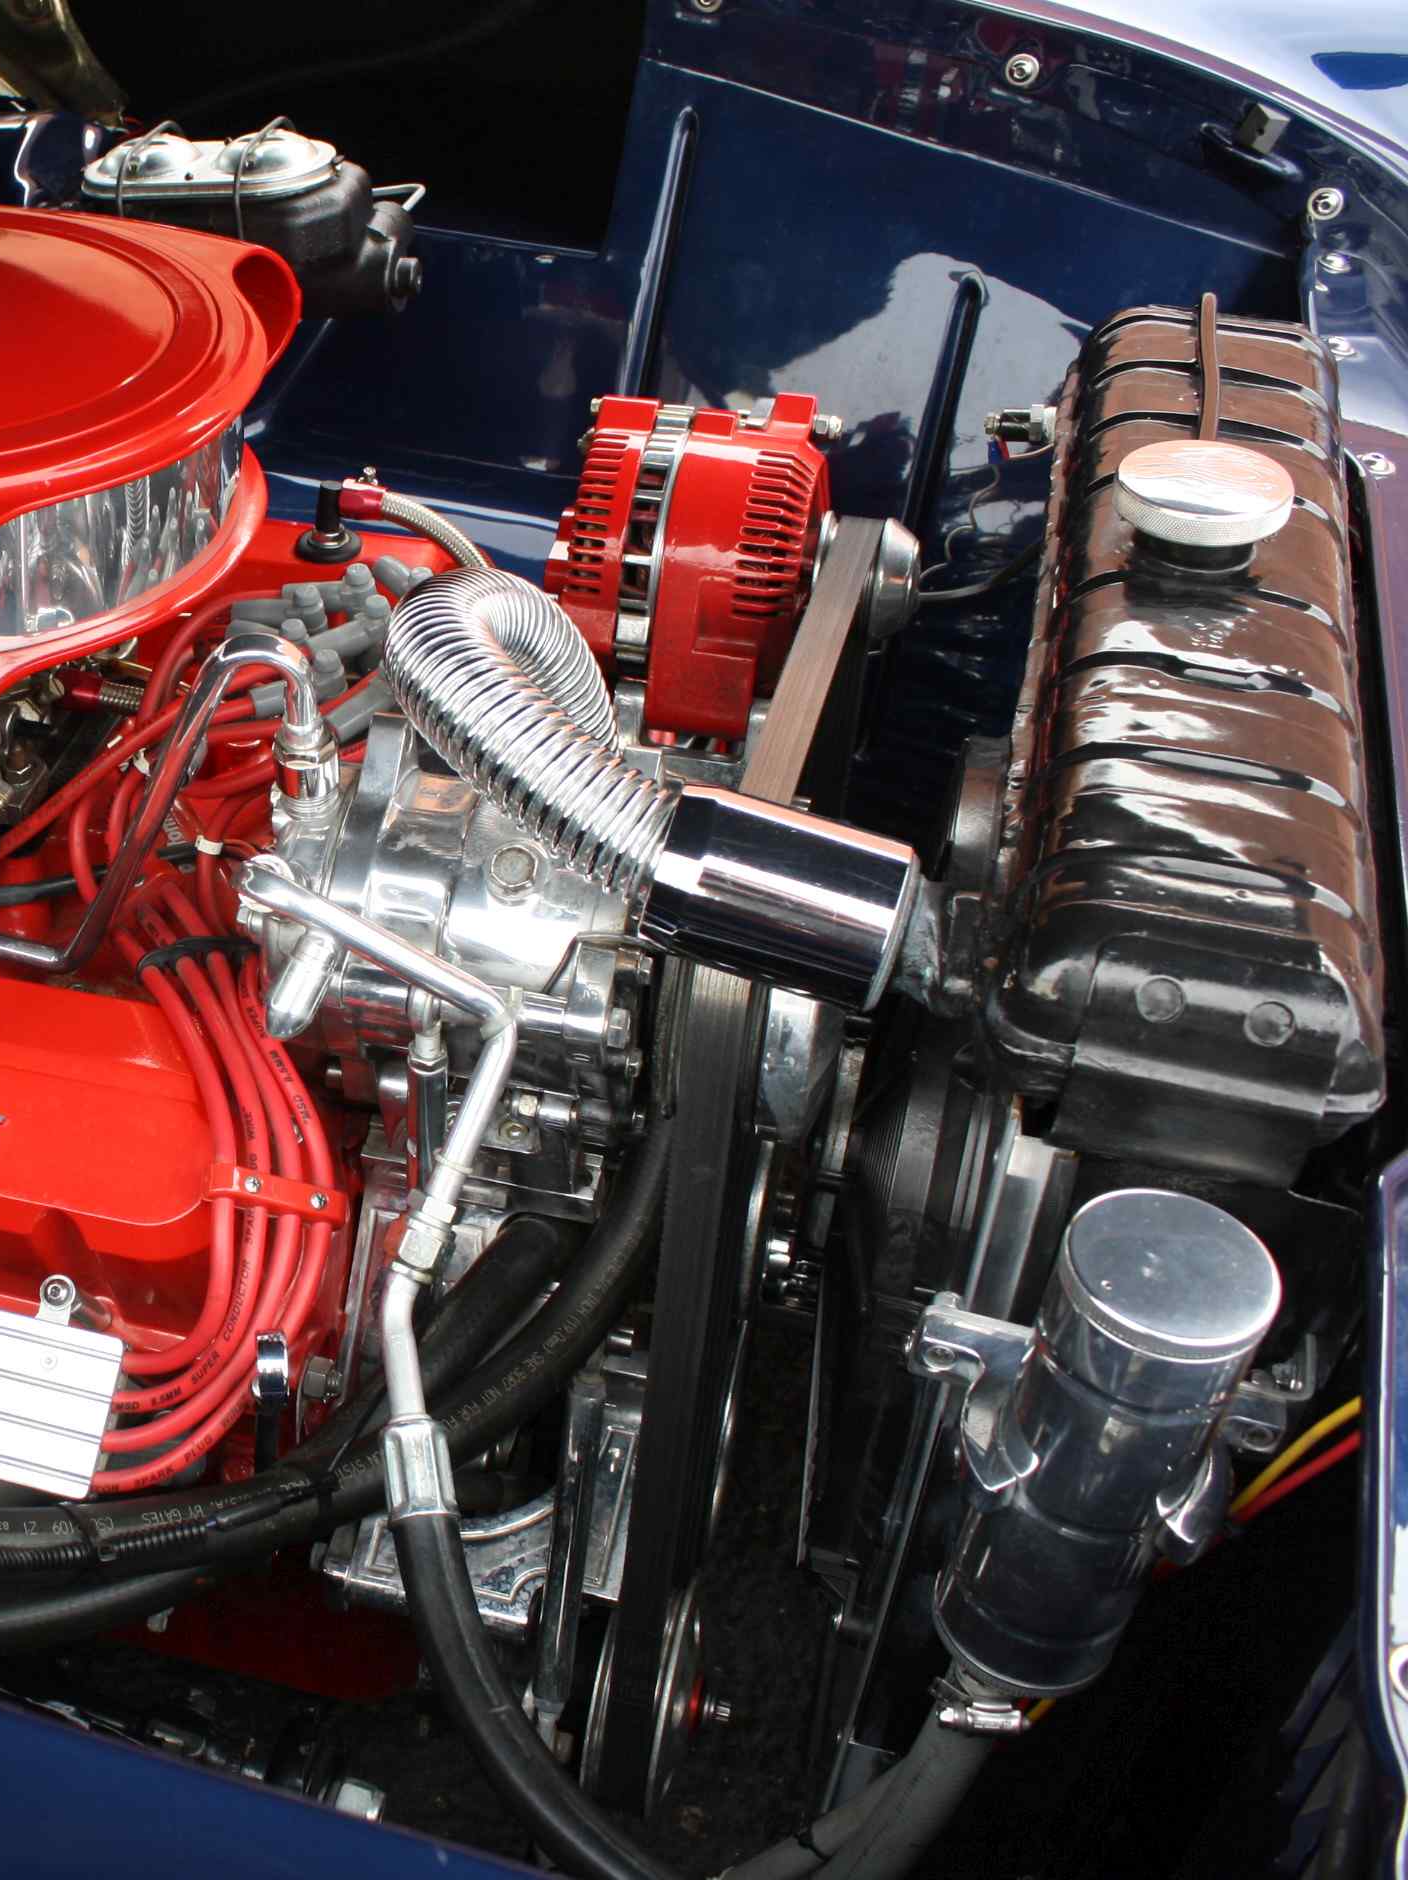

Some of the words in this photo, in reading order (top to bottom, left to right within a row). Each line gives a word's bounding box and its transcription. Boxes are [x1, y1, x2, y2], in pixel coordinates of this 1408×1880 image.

[192, 1351, 221, 1384] SUPER
[223, 1258, 252, 1342] CONDUCTOR
[244, 1206, 258, 1246] SPAR
[142, 1509, 184, 1527] GATES
